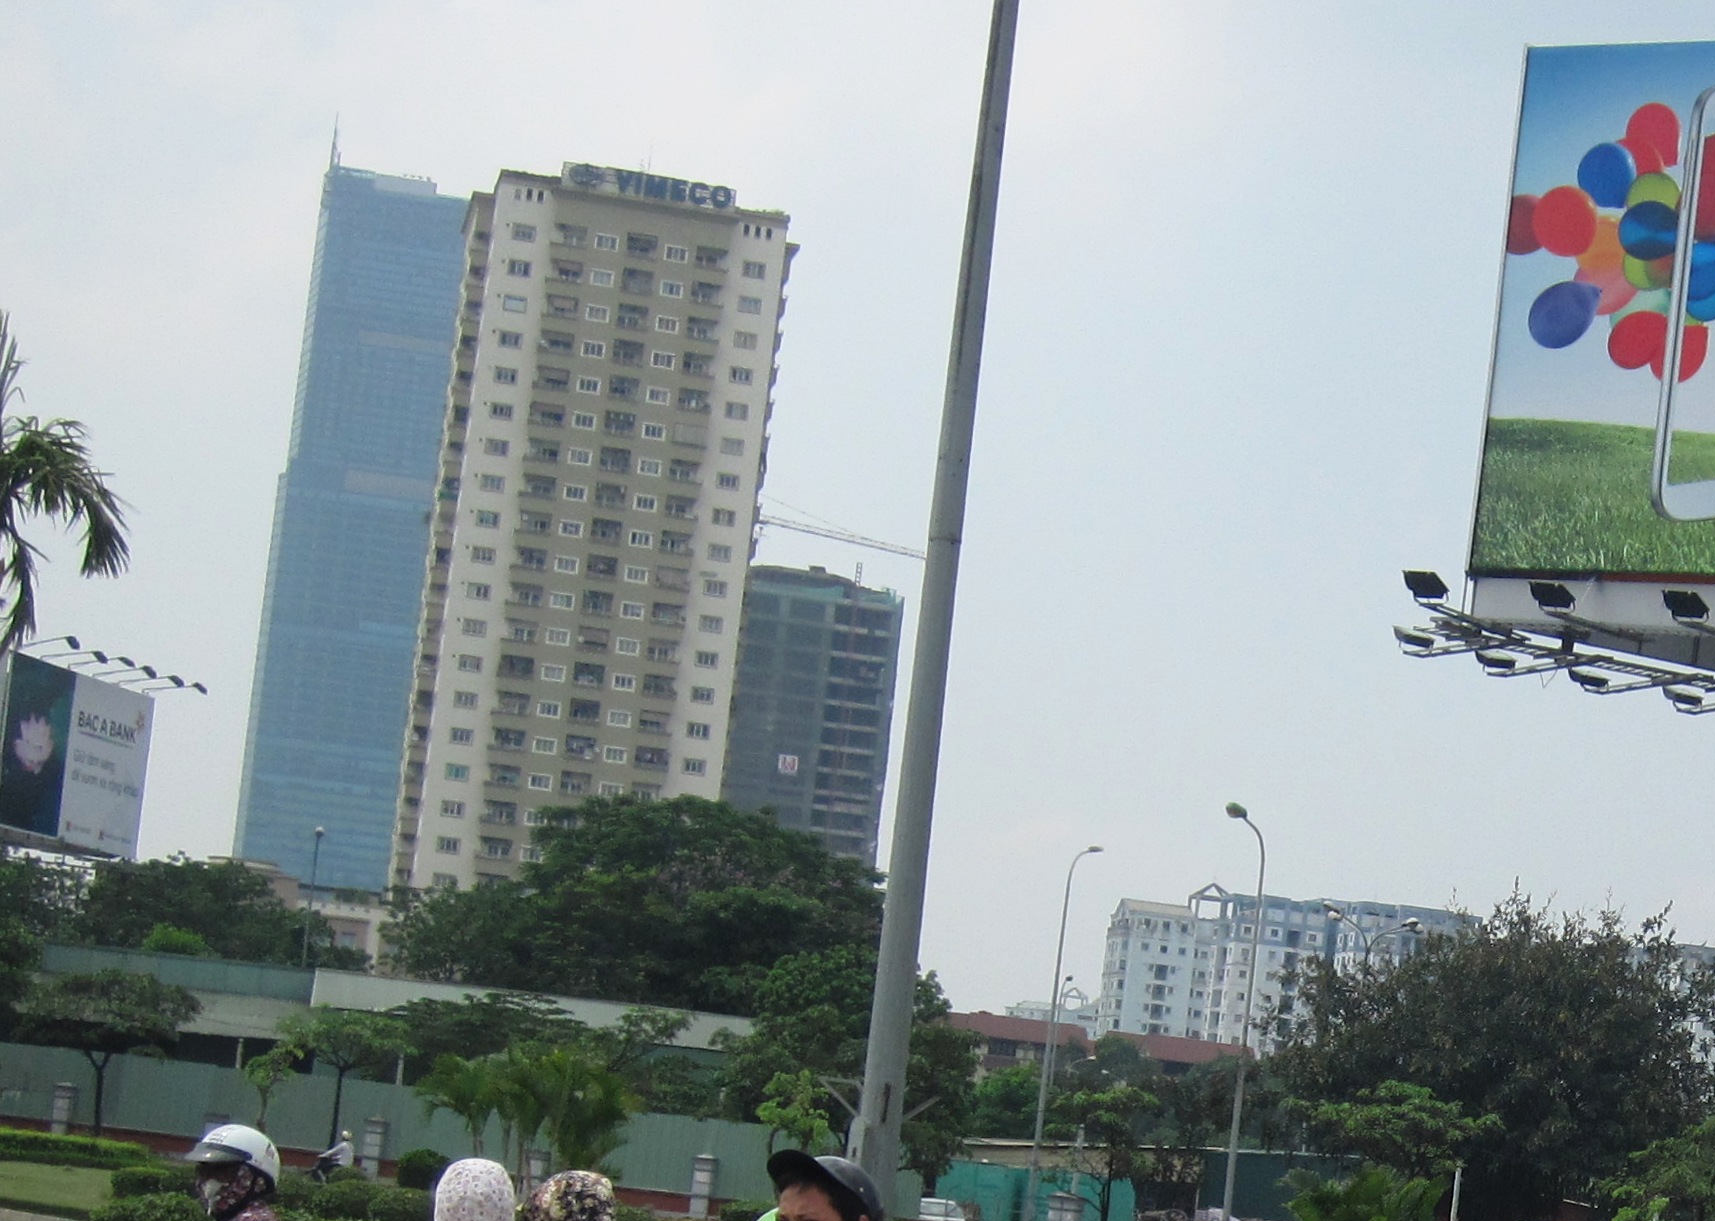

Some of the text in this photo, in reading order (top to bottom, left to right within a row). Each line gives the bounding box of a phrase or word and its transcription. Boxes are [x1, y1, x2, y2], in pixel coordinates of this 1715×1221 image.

[616, 169, 733, 209] VIMECO
[78, 711, 99, 732] BAC
[109, 721, 137, 744] BANK
